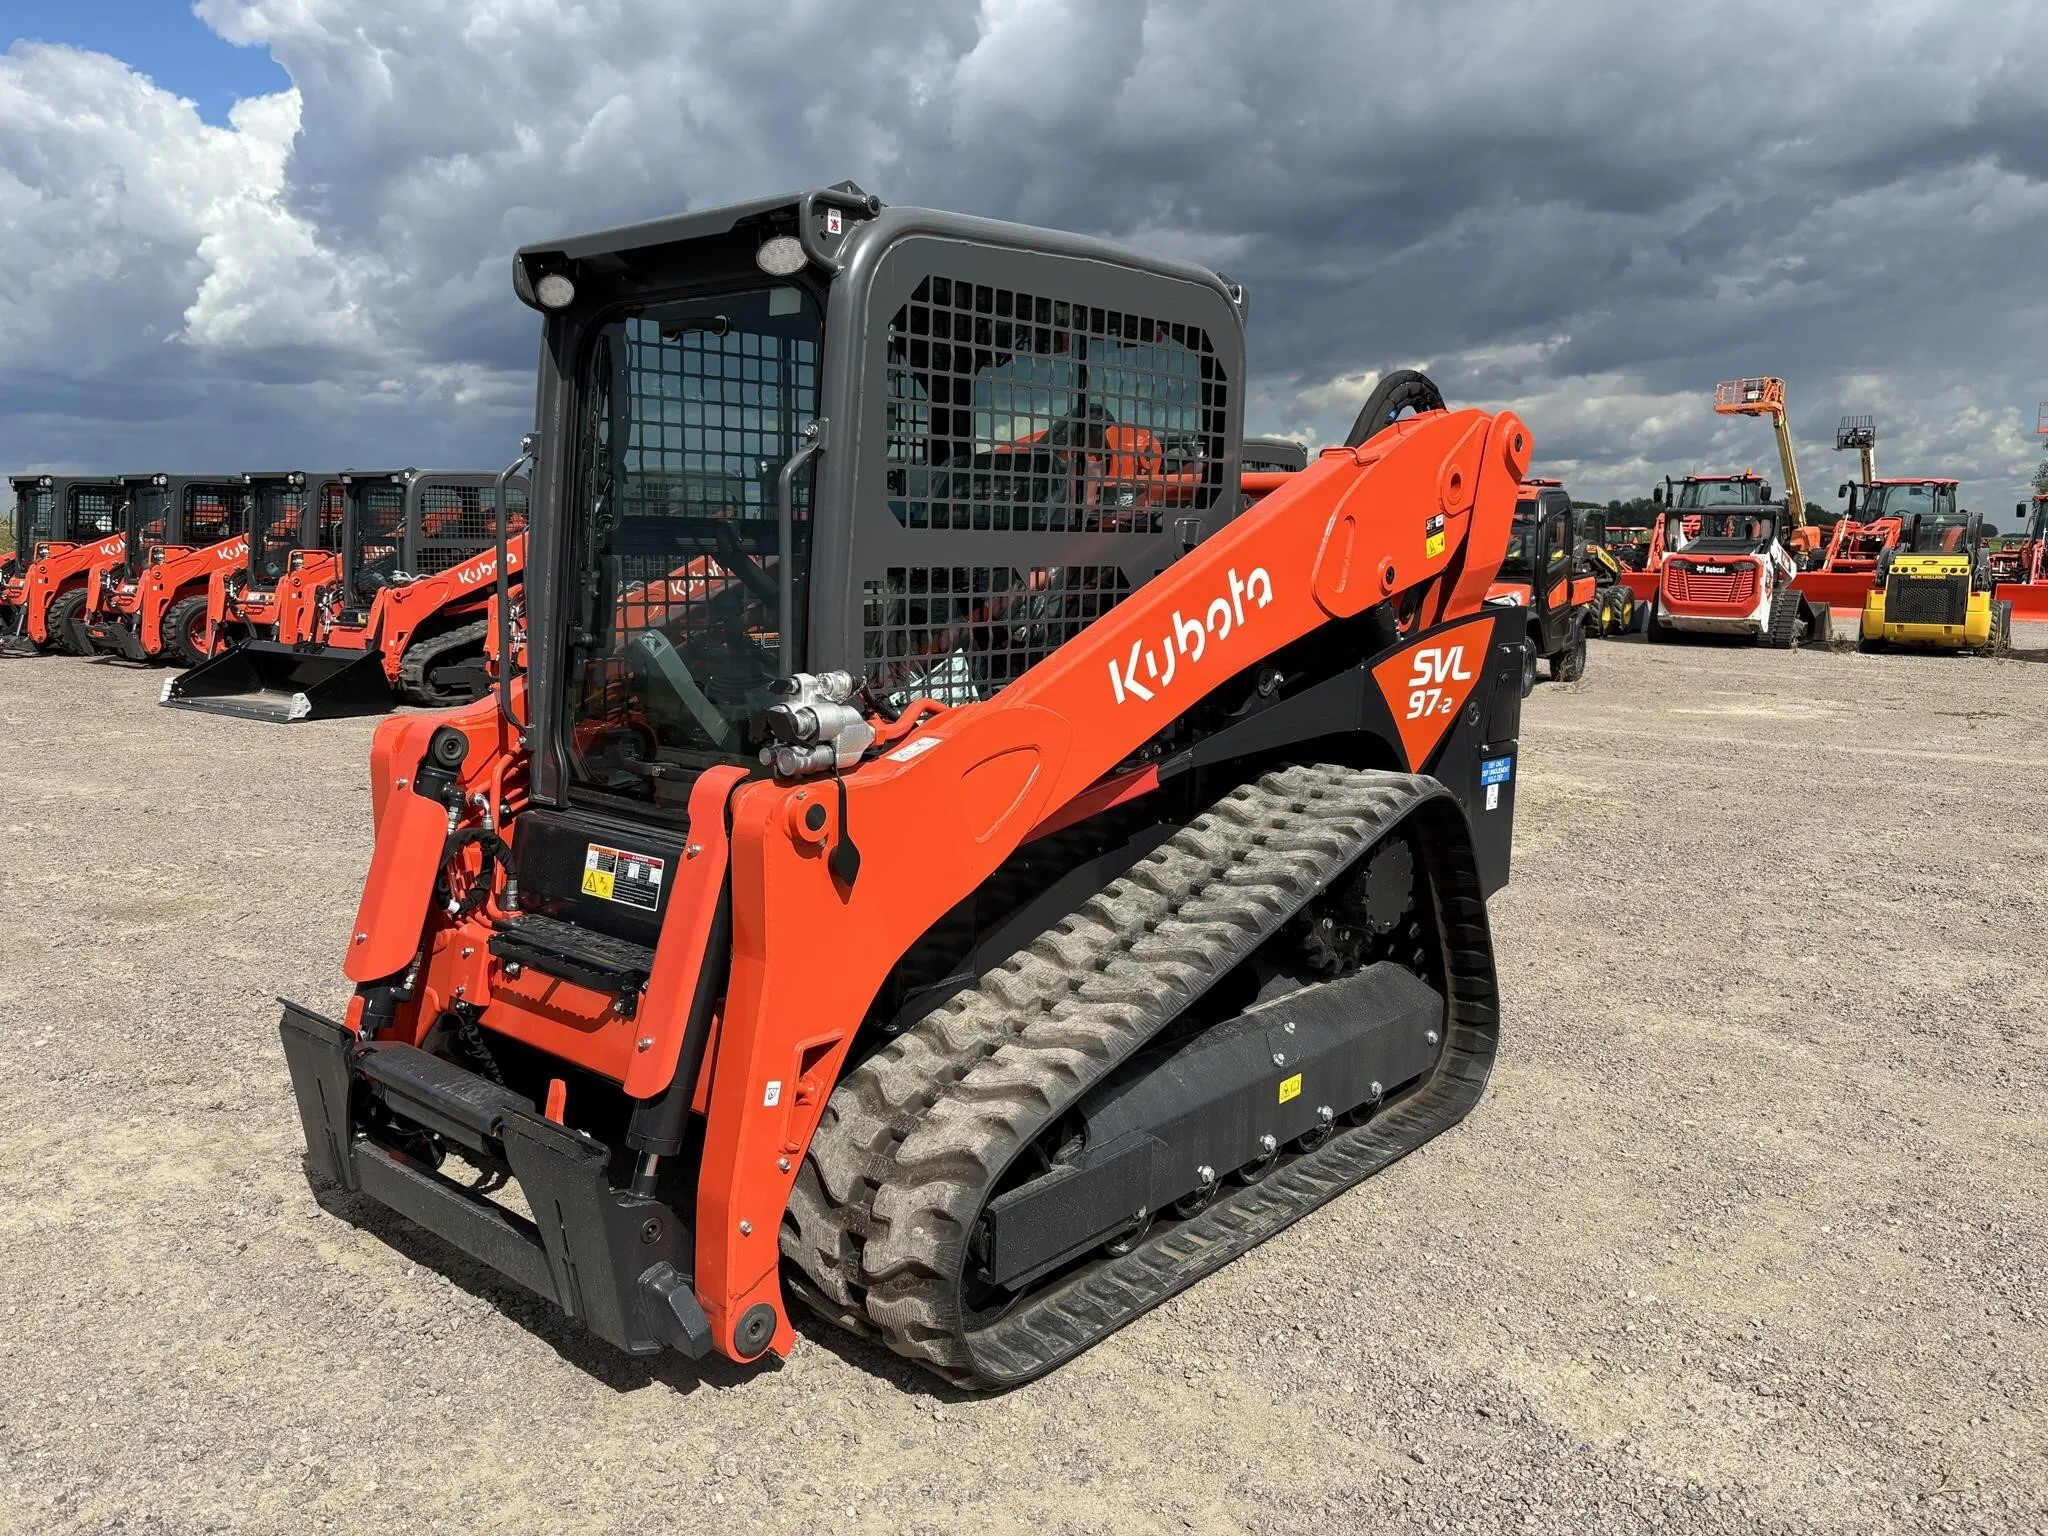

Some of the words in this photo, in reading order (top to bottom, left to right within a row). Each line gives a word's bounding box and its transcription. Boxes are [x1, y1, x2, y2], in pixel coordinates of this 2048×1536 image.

[457, 552, 517, 584] Kuba
[1705, 566, 1726, 574] Bobcat
[1108, 567, 1273, 704] Kubota
[1408, 646, 1471, 687] SVL
[1406, 688, 1453, 719] 97-2
